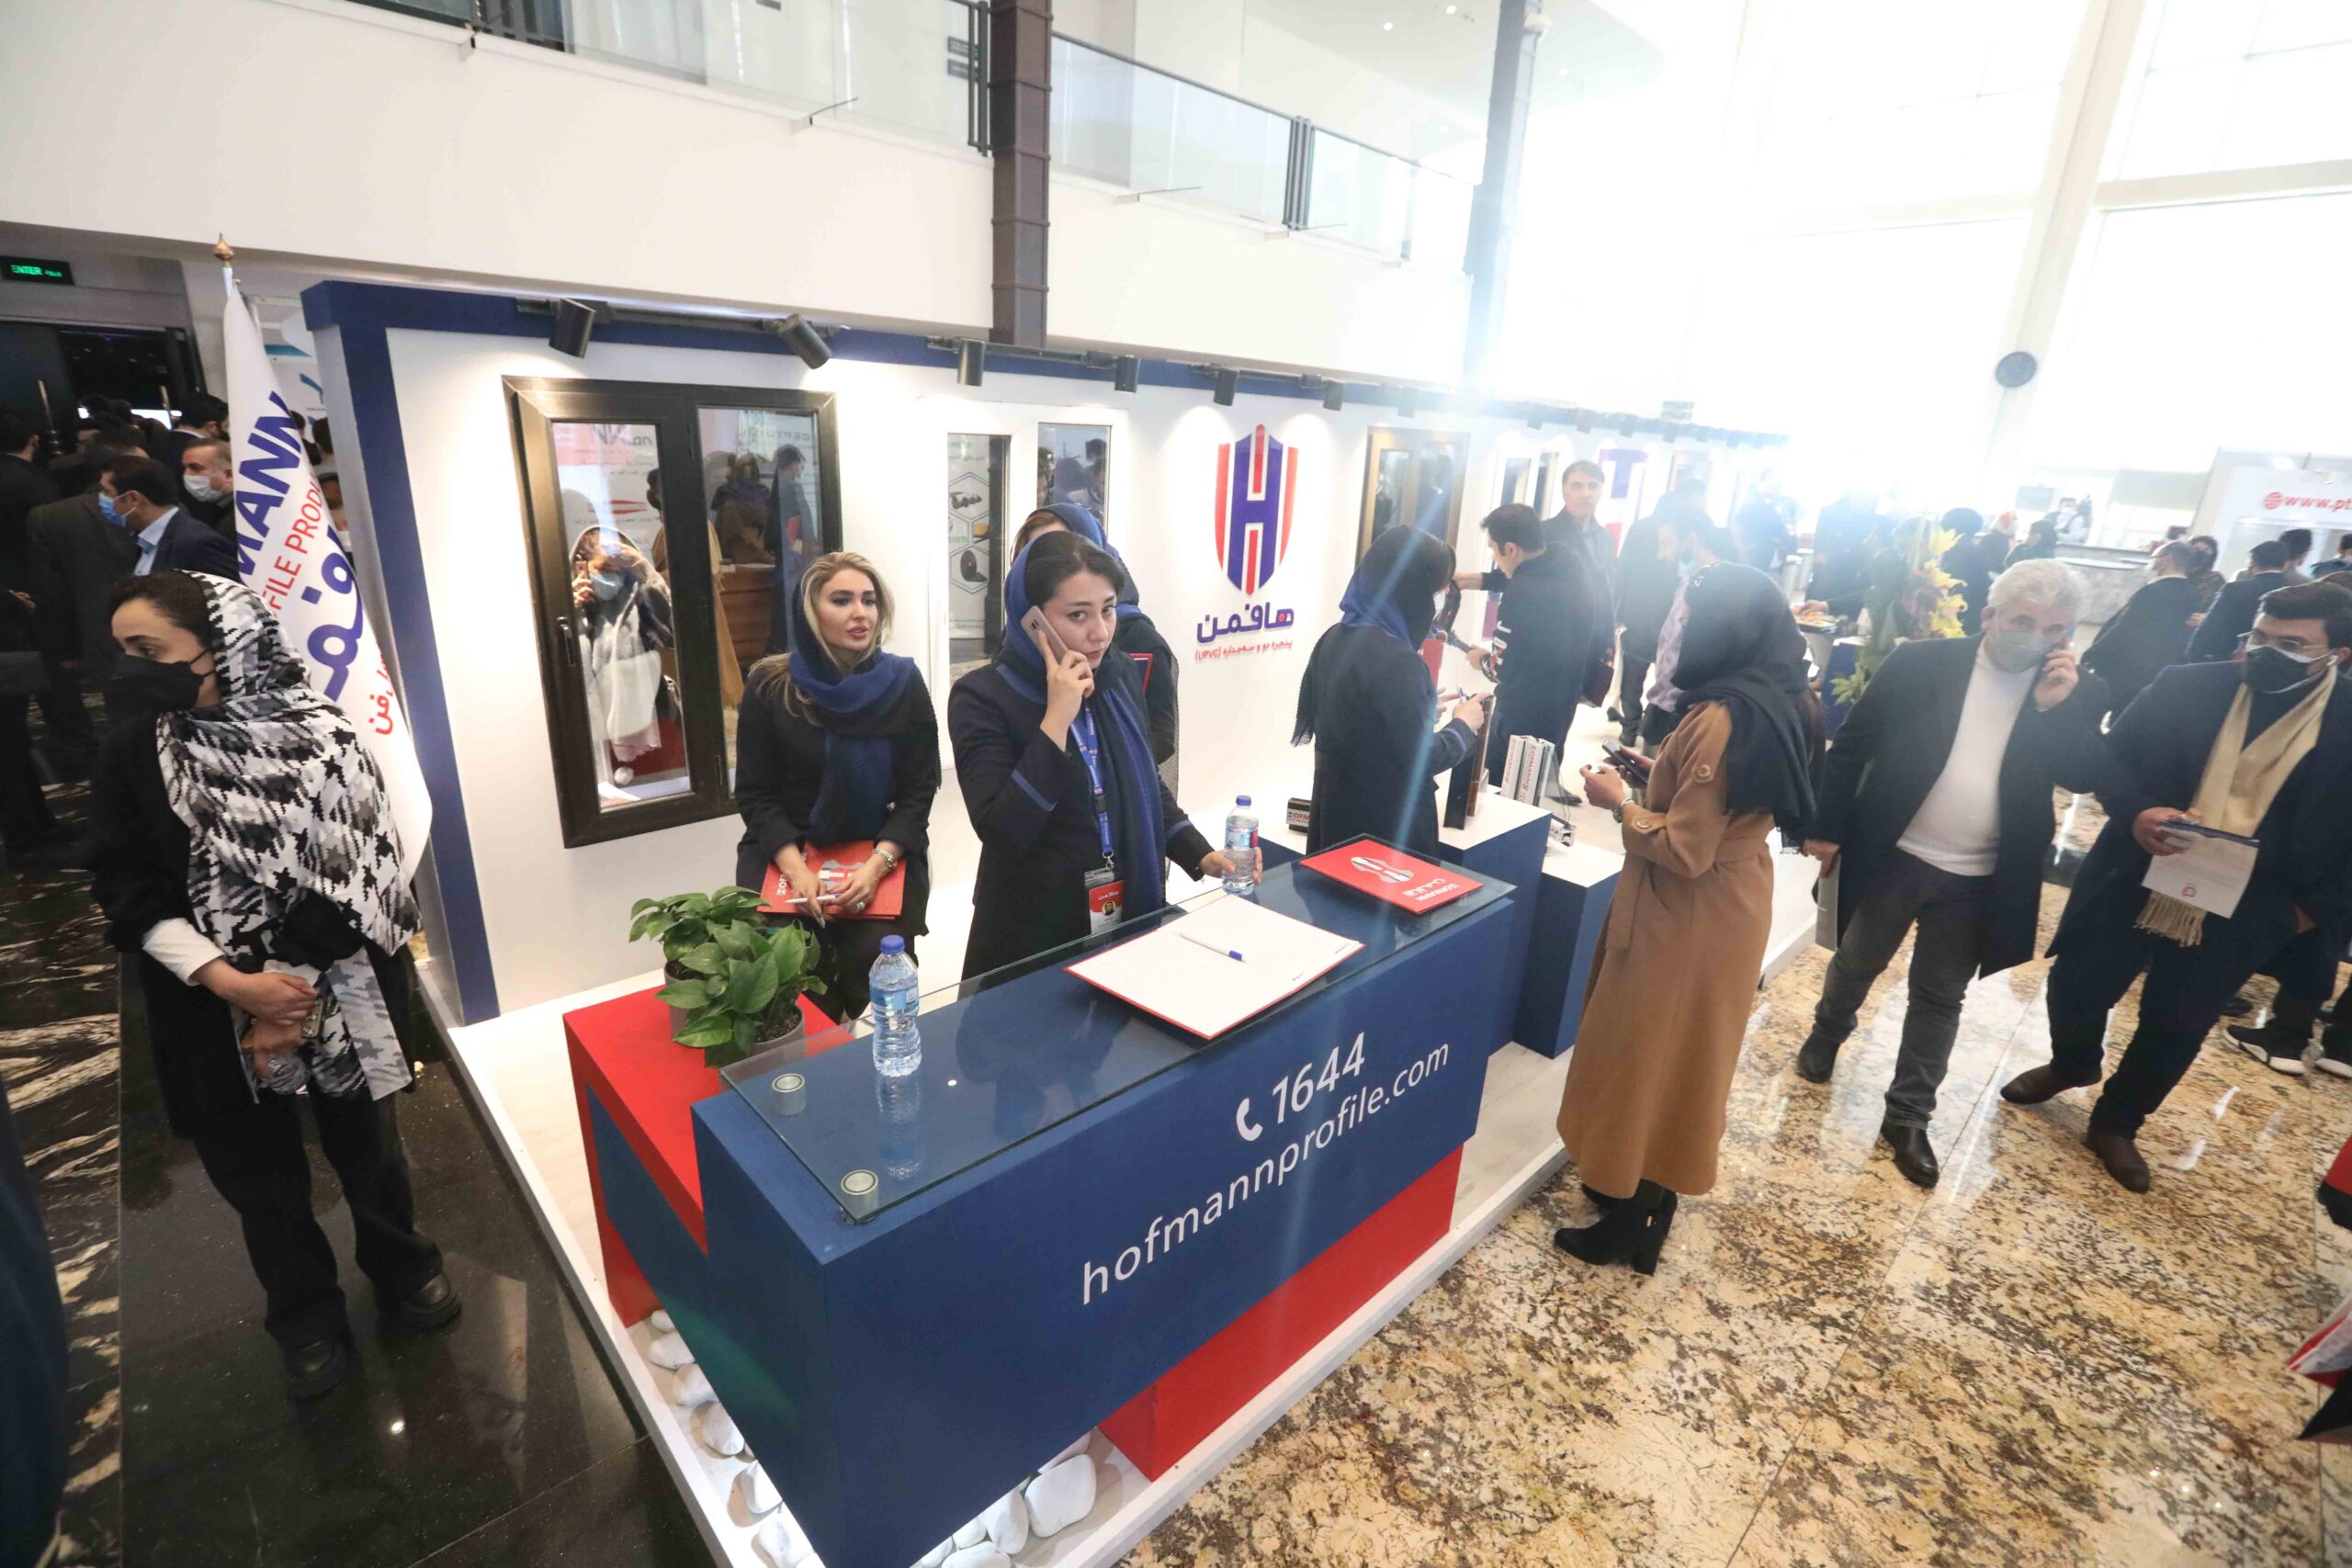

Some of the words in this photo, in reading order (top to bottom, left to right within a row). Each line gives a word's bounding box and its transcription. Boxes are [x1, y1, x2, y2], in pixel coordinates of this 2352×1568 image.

[262, 555, 301, 614] FILE
[1197, 601, 1294, 643] هافمن
[1272, 1032, 1364, 1123] 1644
[1082, 1043, 1449, 1305] hofmannprofile.com
